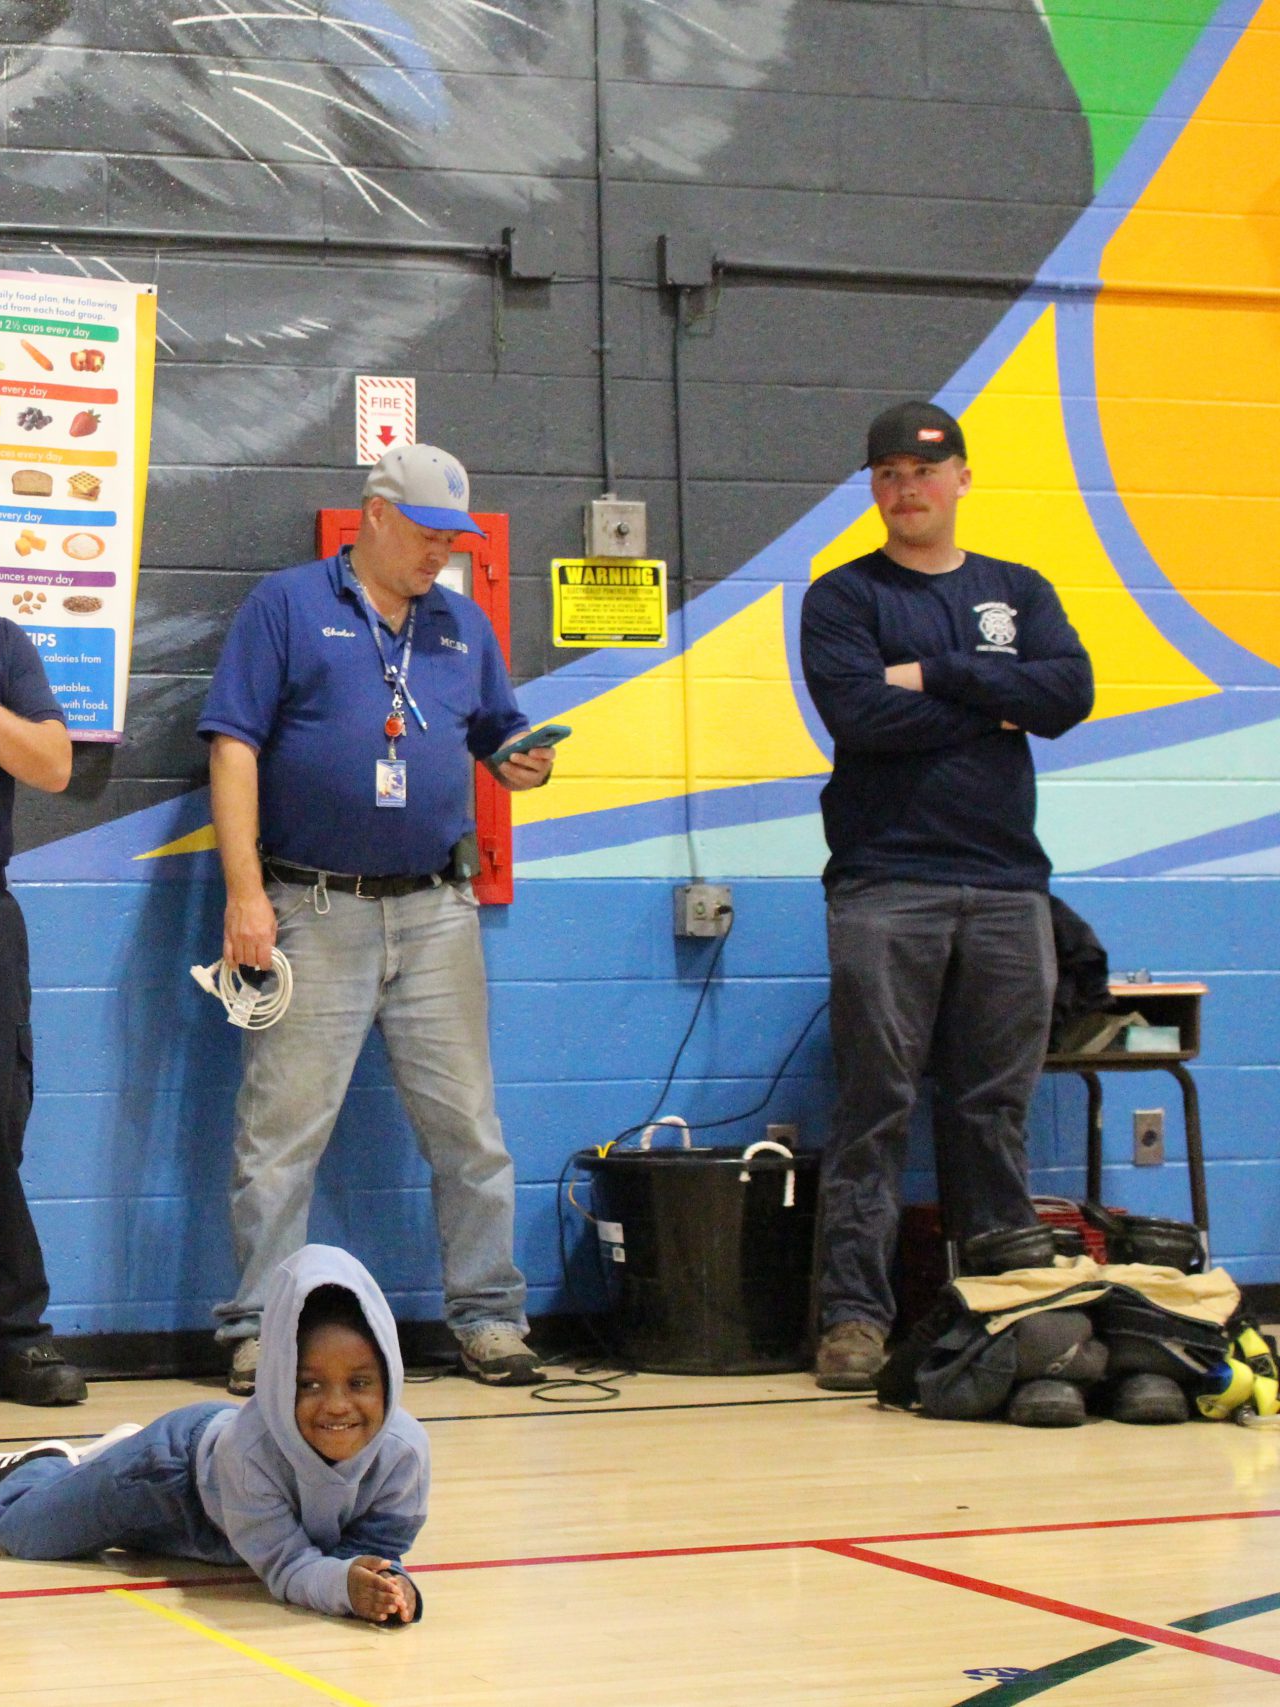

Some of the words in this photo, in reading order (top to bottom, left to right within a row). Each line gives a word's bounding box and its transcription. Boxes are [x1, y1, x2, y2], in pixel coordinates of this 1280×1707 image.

[16, 292, 36, 301] food
[63, 296, 75, 305] the
[78, 297, 118, 311] following
[11, 303, 31, 312] from
[33, 306, 54, 315] each
[56, 307, 76, 317] food
[22, 323, 44, 334] cups
[46, 326, 70, 336] every
[73, 325, 90, 339] day
[1, 386, 27, 396] every
[29, 385, 48, 398] day
[371, 397, 401, 409] FIRE
[17, 449, 44, 461] every
[46, 449, 64, 463] day
[24, 510, 42, 523] day
[27, 573, 53, 584] every
[55, 573, 74, 586] day
[565, 566, 654, 585] WARNING
[44, 652, 79, 663] calories
[81, 652, 102, 663] from
[62, 698, 80, 709] with
[82, 698, 108, 710] foods
[68, 711, 98, 722] bread.
